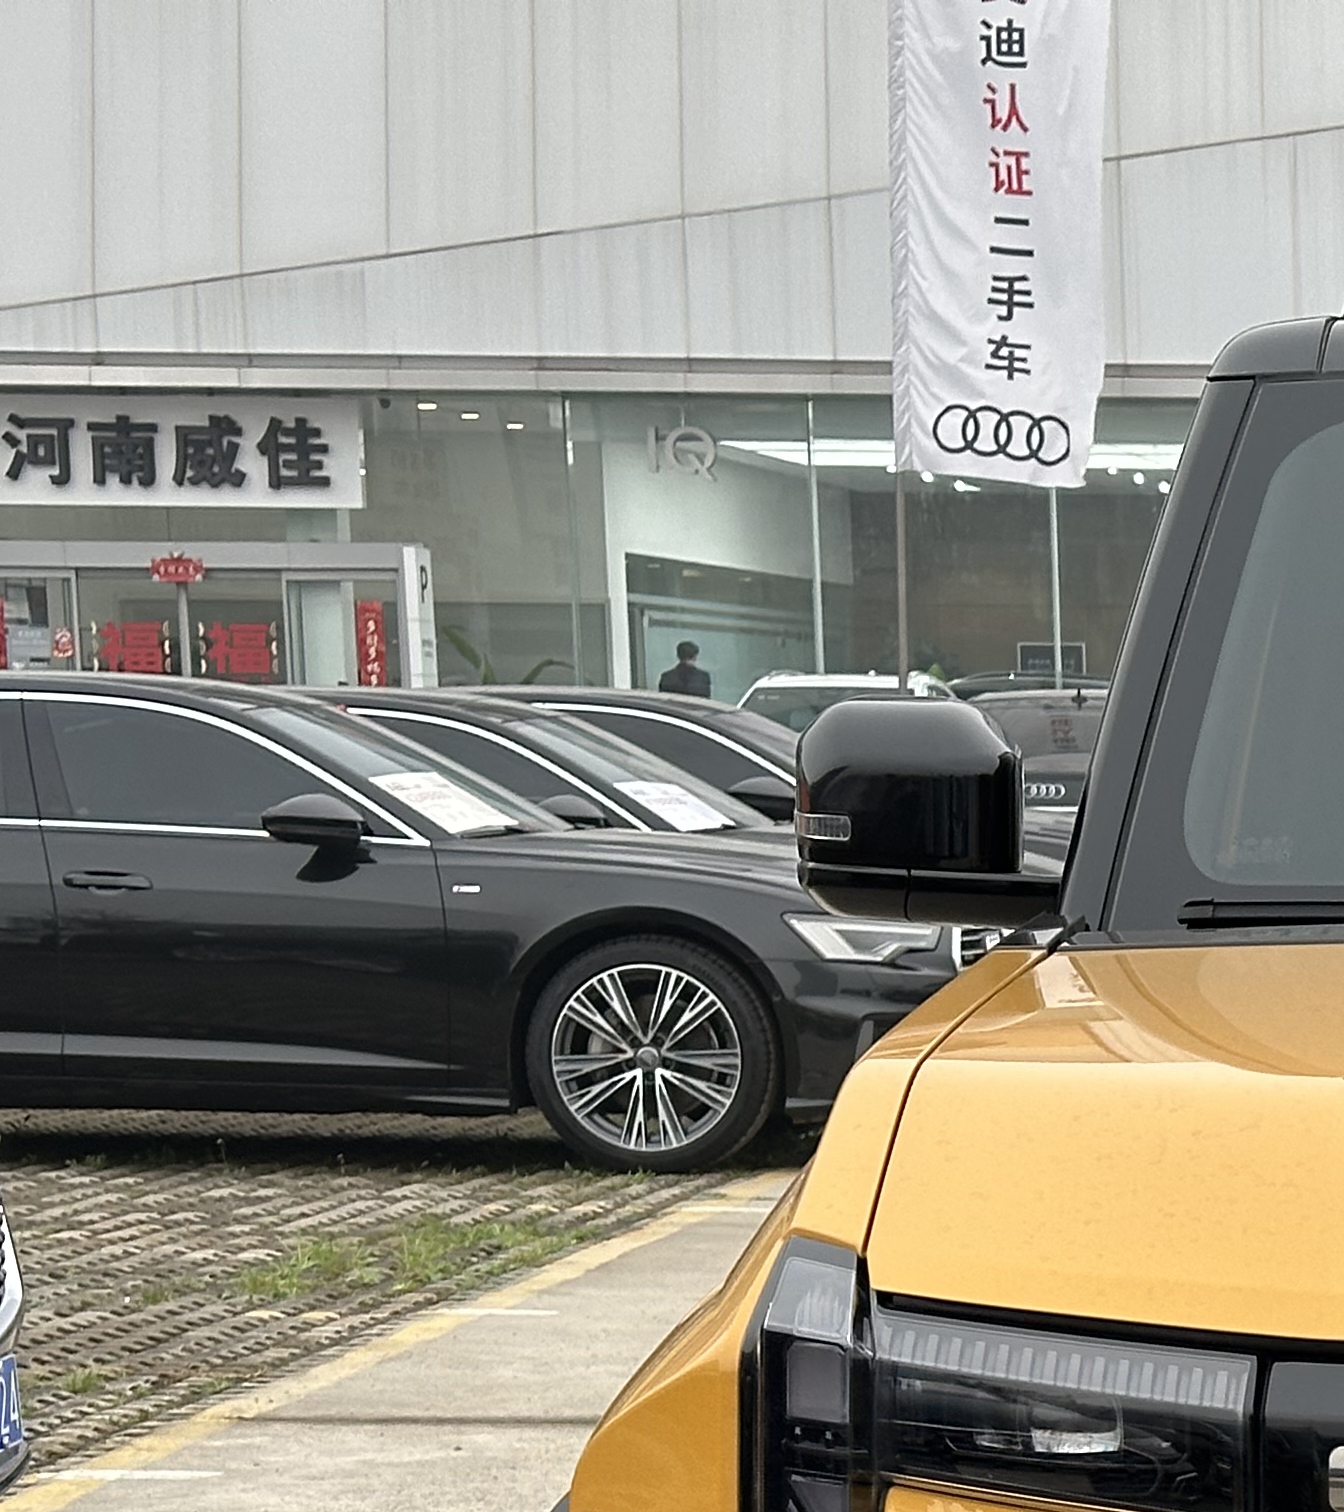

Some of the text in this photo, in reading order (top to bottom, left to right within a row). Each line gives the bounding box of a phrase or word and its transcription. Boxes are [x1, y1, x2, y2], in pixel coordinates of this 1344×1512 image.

[979, 0, 1034, 381] 迪认证二手车
[1, 412, 331, 490] 河南威佳
[101, 620, 163, 672] 福
[207, 620, 270, 674] 福
